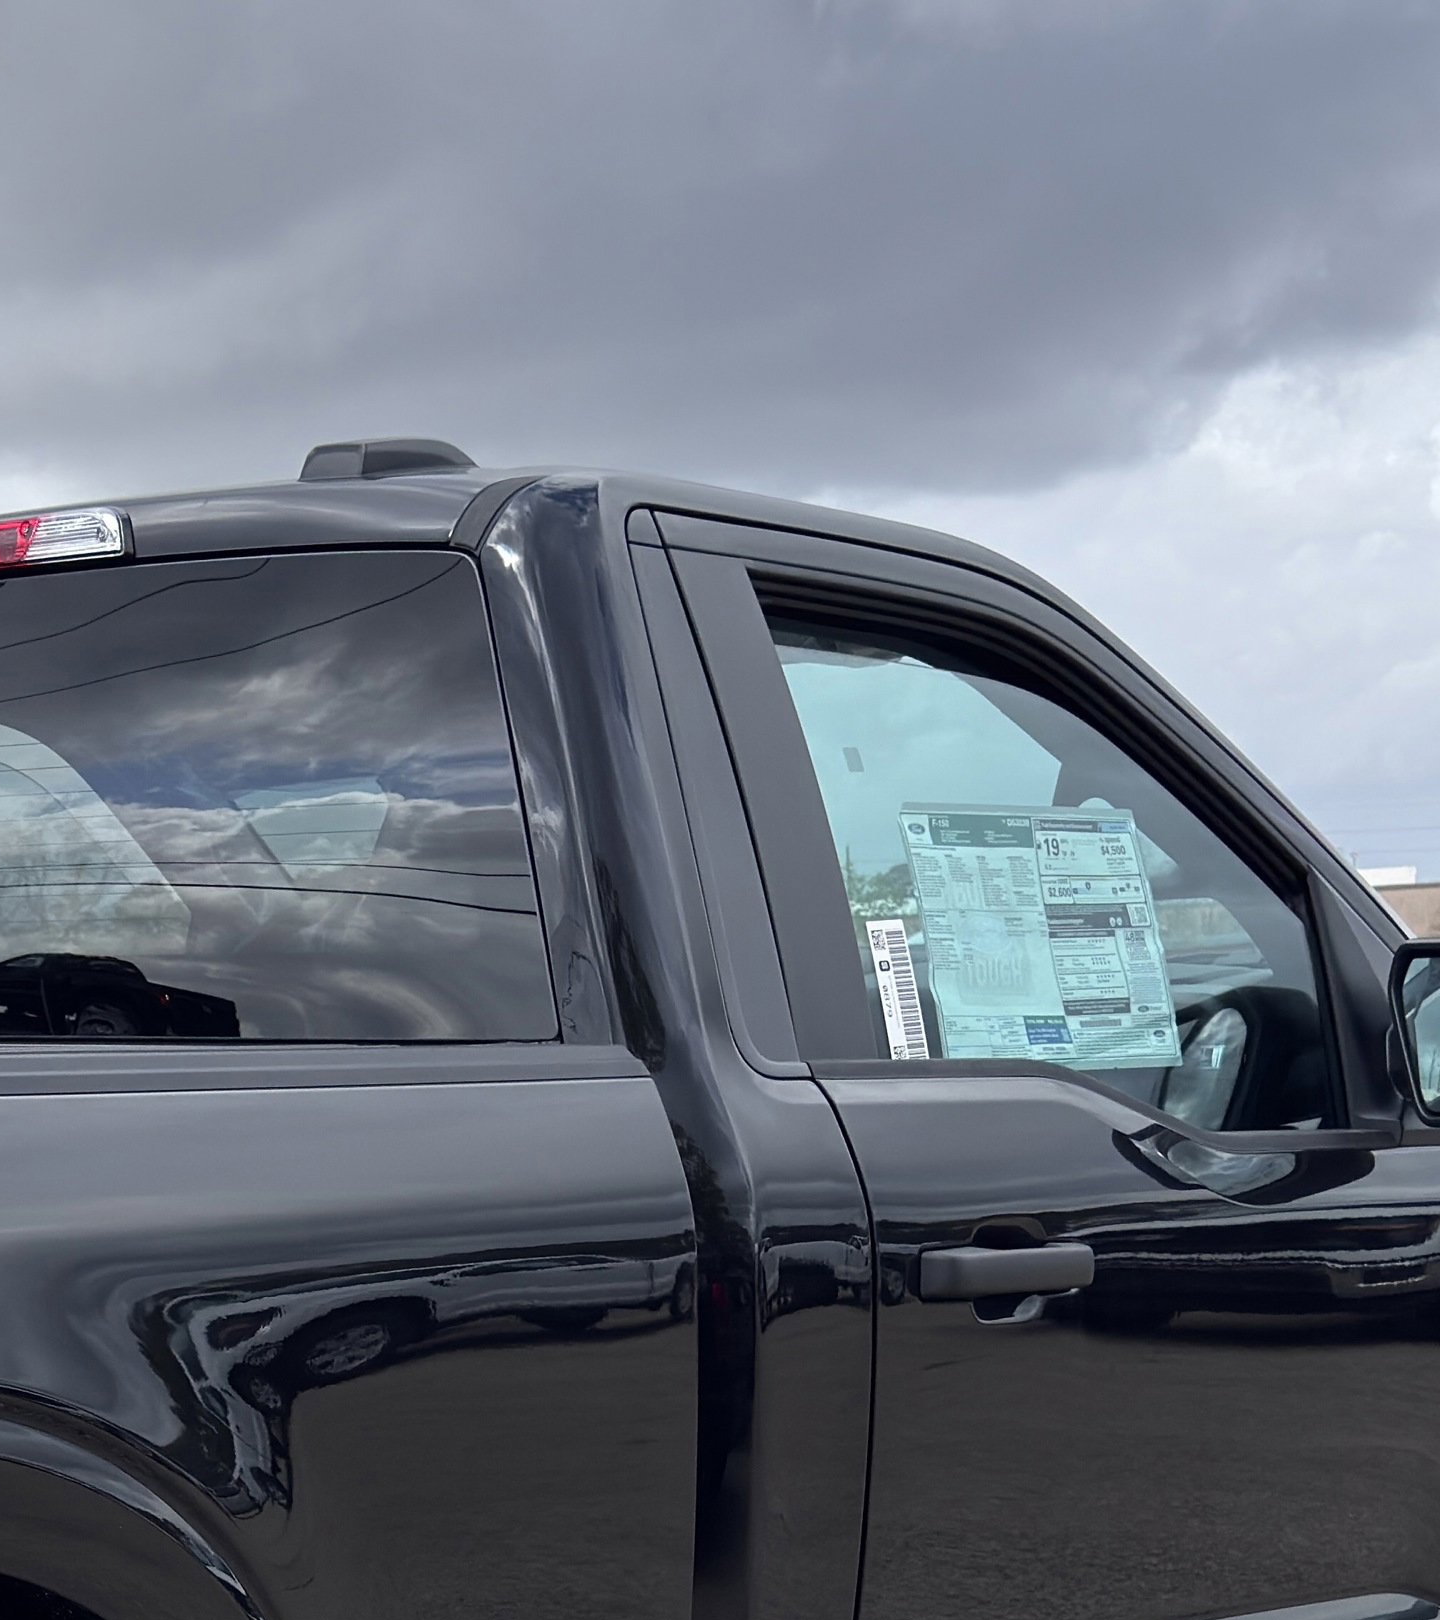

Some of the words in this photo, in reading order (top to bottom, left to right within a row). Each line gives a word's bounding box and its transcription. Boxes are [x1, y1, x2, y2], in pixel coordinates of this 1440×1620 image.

[1043, 838, 1060, 856] 19
[1101, 845, 1126, 856] $4,500
[1048, 887, 1071, 898] $2,600
